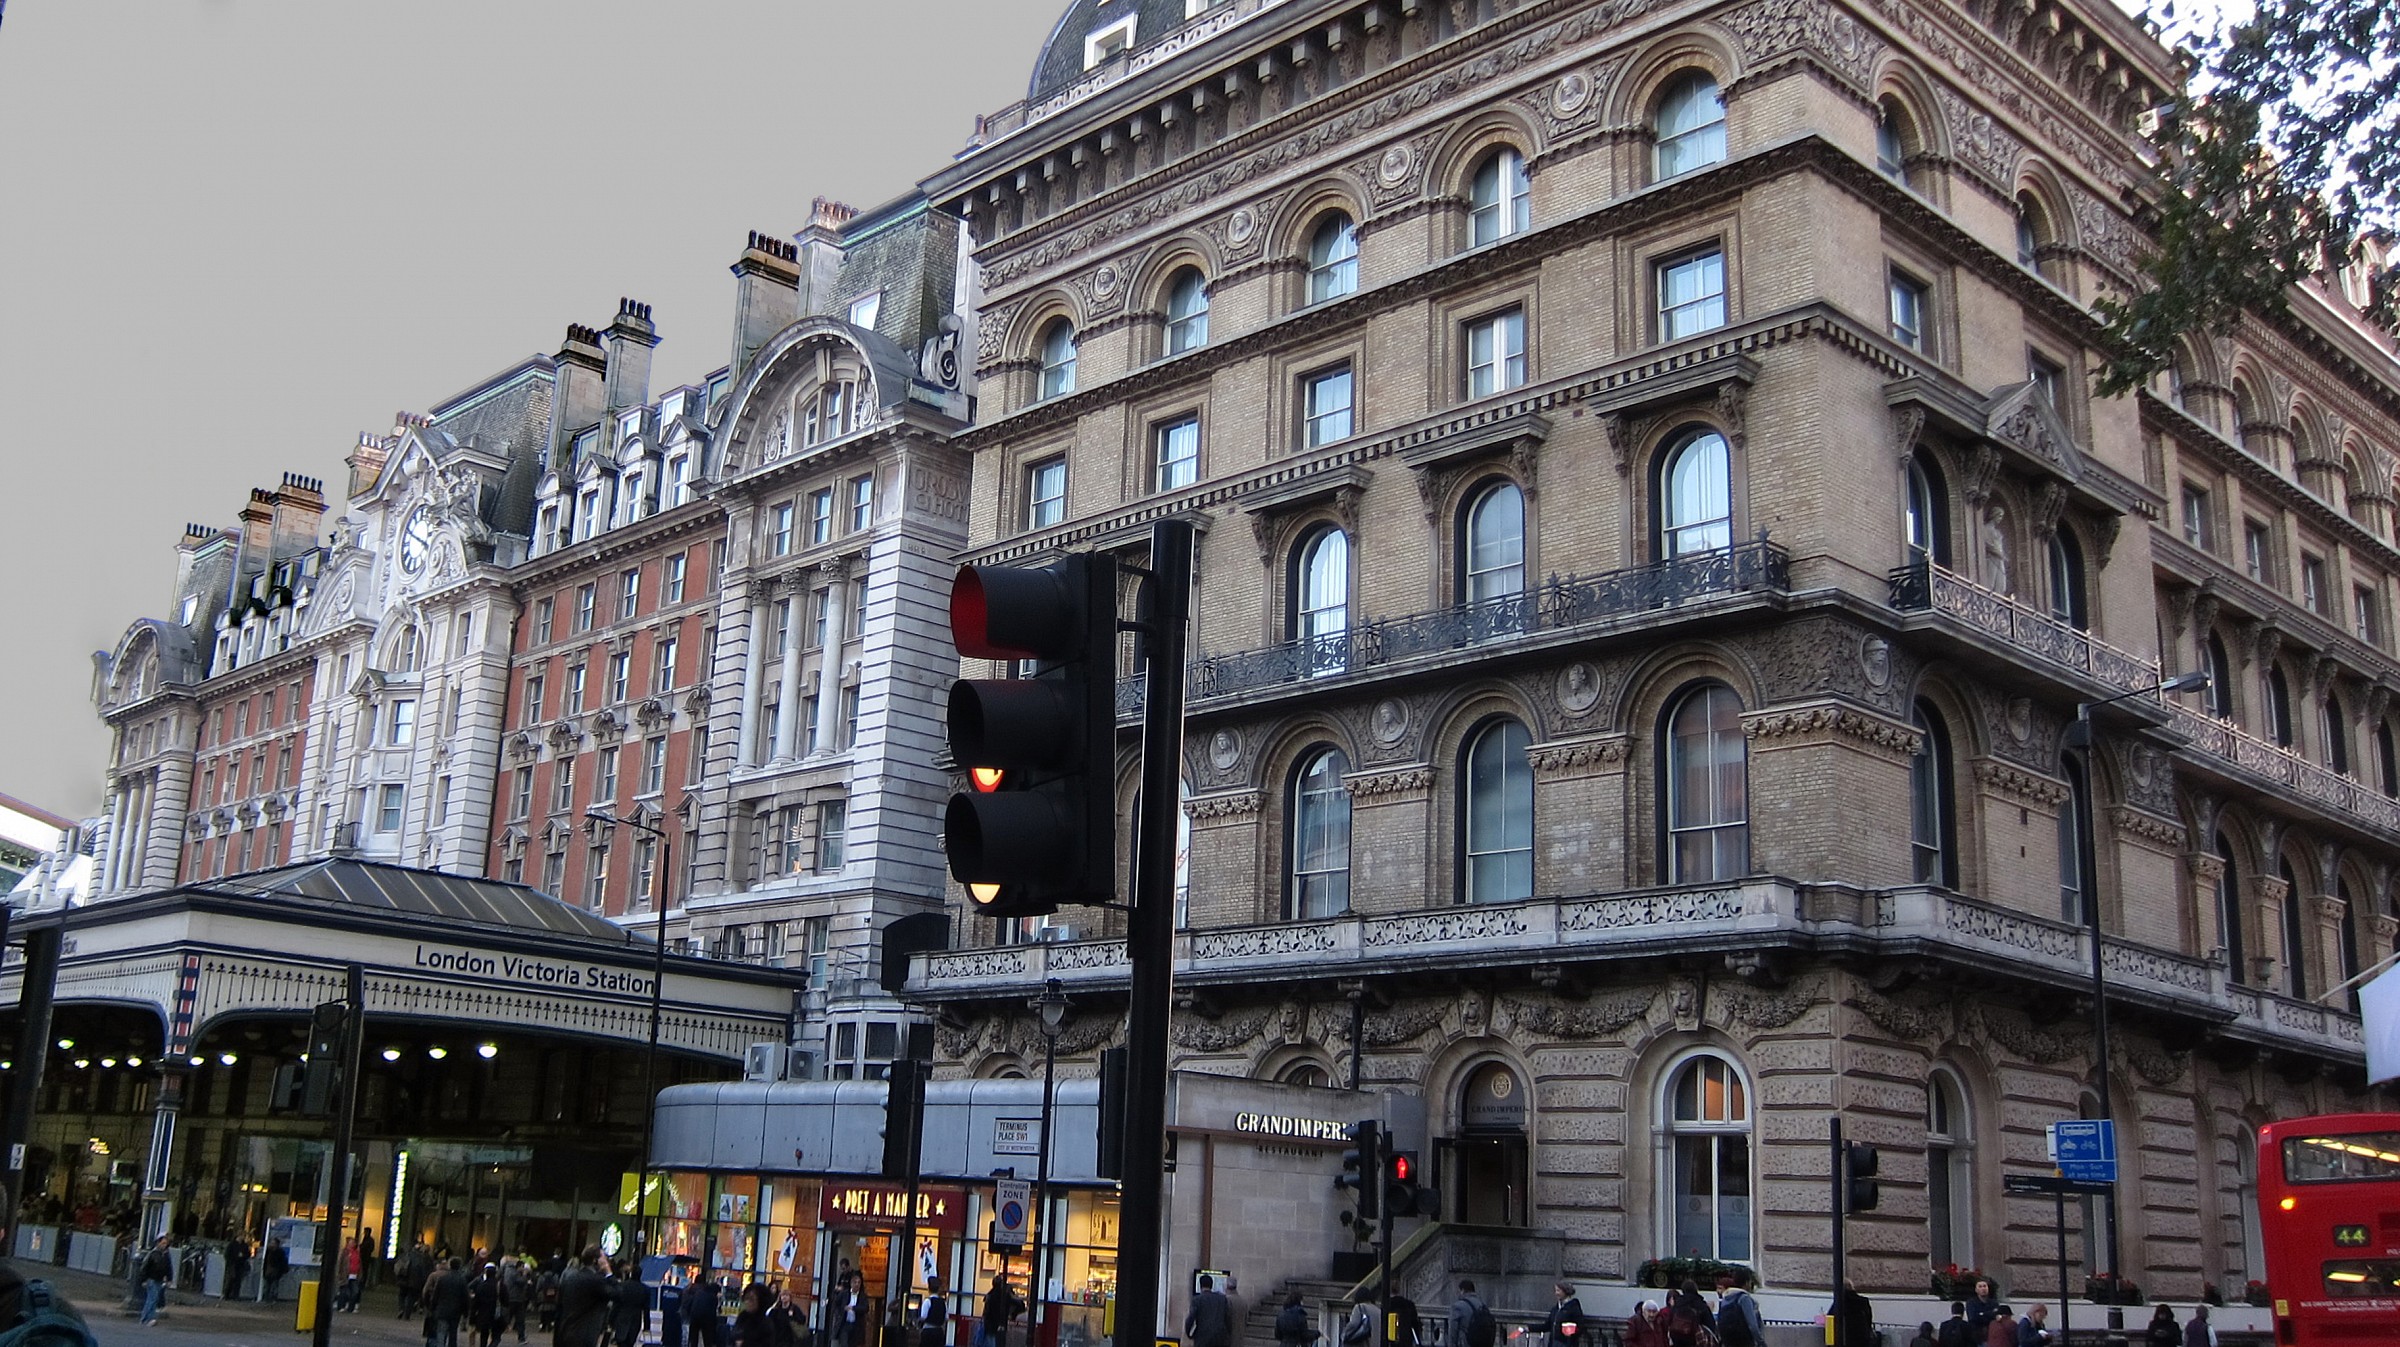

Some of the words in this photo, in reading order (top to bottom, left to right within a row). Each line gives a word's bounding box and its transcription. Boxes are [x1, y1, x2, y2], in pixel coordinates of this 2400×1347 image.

[415, 944, 495, 975] London
[502, 955, 580, 985] Victoria
[586, 966, 656, 995] Station
[1000, 1121, 1028, 1131] TERMINUS
[1236, 1112, 1354, 1141] GRANDIMPERI
[998, 1132, 1014, 1141] PLACE
[1016, 1132, 1028, 1141] SW1
[1260, 1145, 1323, 1158] RESTAURANT
[1000, 1181, 1028, 1190] Controlled
[1003, 1190, 1024, 1200] ZONE
[844, 1189, 869, 1215] PRET
[872, 1192, 881, 1216] A
[885, 1192, 930, 1219] MANER
[2338, 1229, 2366, 1244] 44
